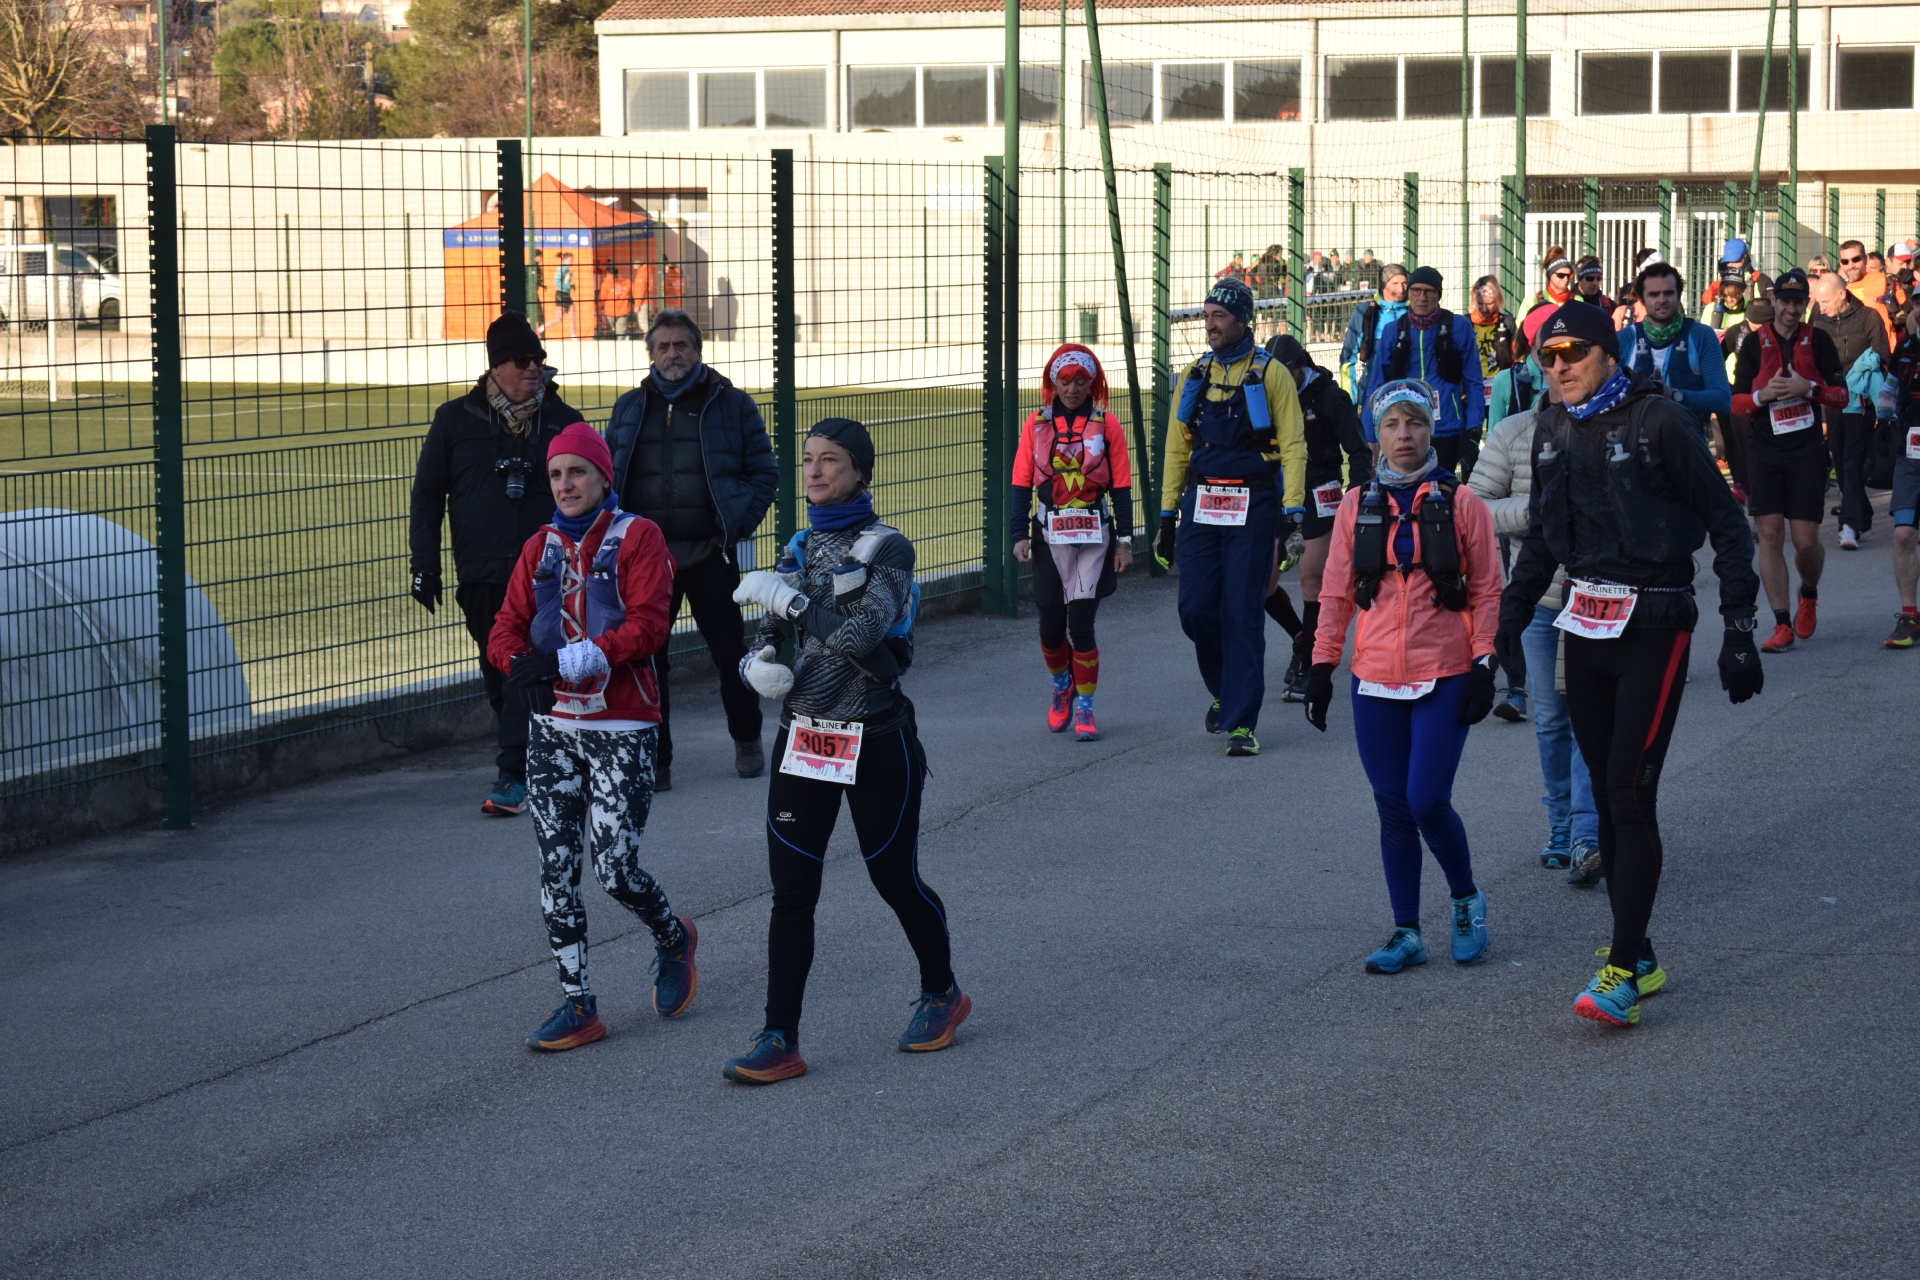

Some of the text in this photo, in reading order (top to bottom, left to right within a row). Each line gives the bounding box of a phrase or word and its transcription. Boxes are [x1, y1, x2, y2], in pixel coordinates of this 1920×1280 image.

[1776, 402, 1807, 421] 3048
[1204, 495, 1241, 511] 3038
[1056, 517, 1093, 531] 3038
[1587, 584, 1628, 595] GALINETTE
[1576, 595, 1624, 620] 3077
[798, 731, 850, 758] 3057
